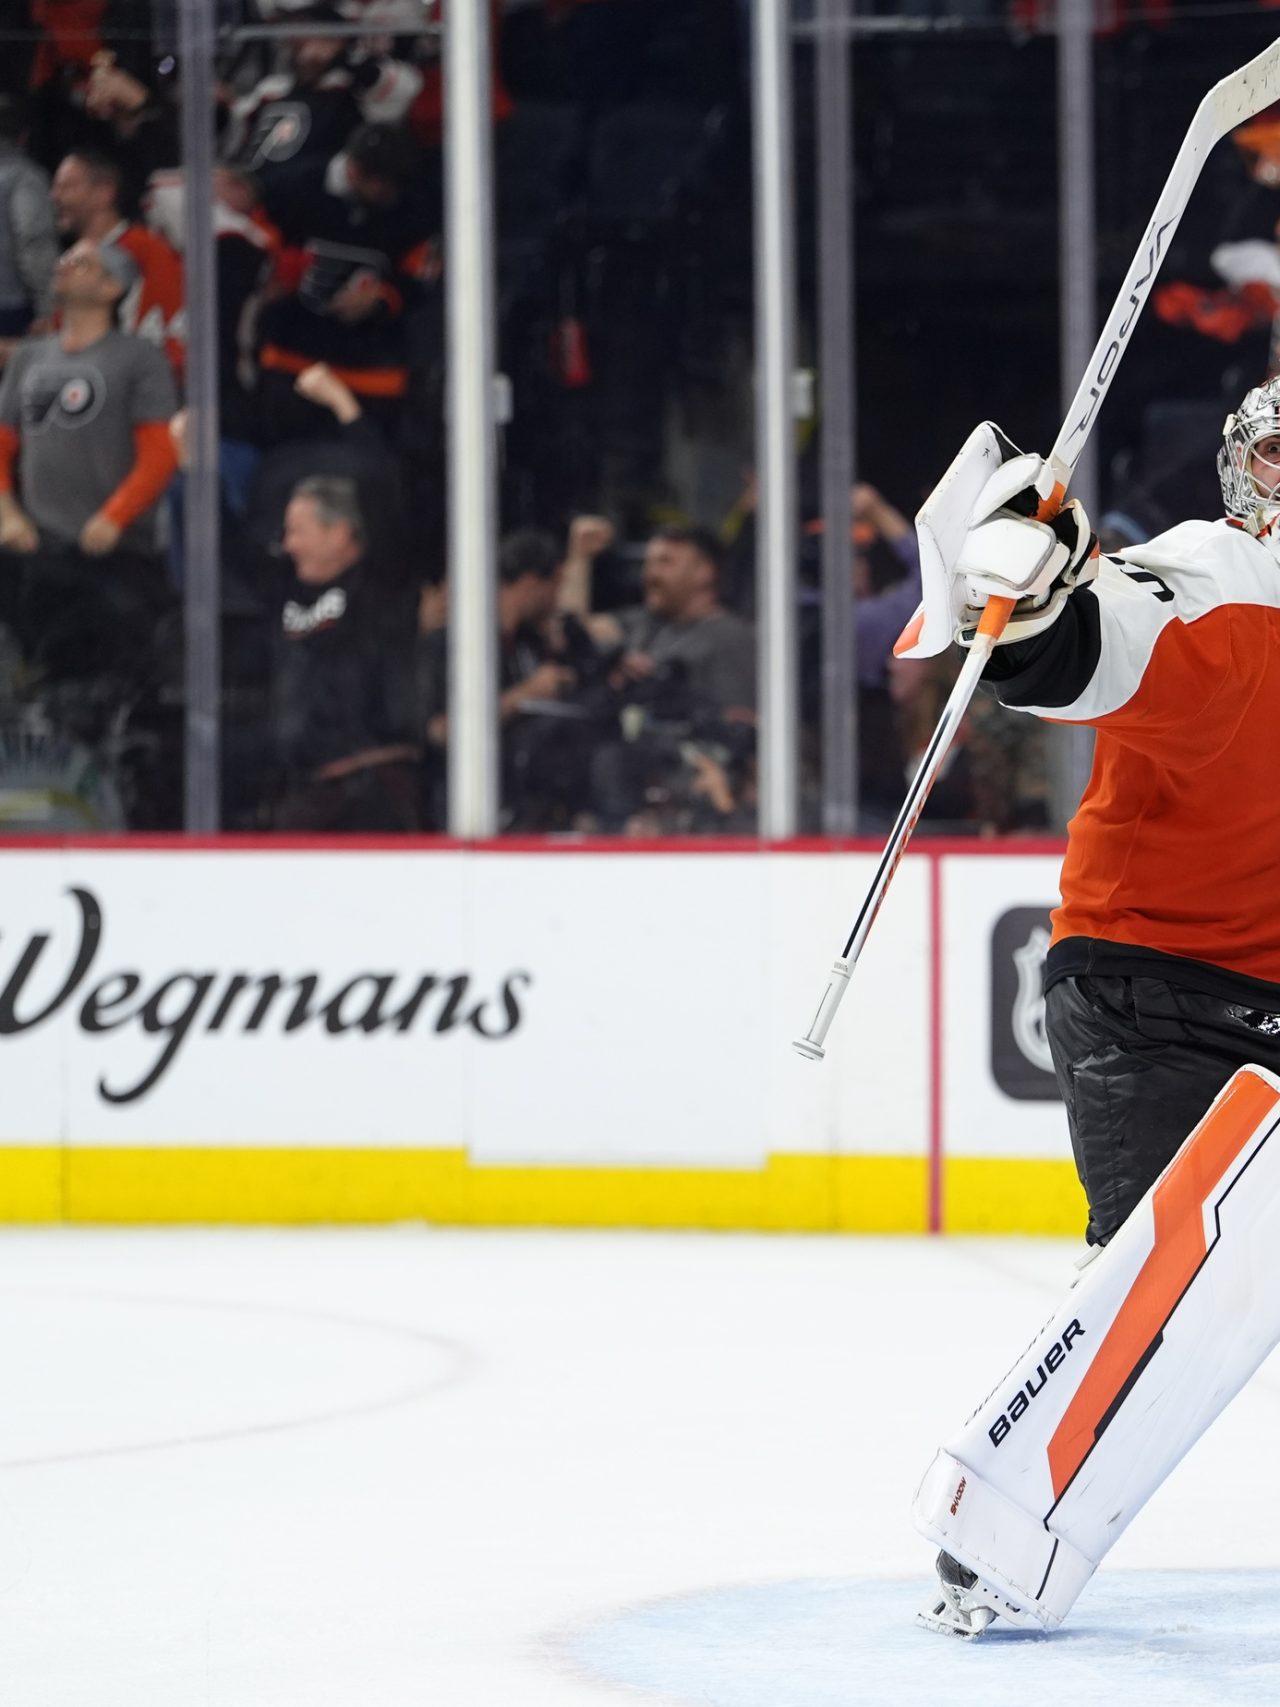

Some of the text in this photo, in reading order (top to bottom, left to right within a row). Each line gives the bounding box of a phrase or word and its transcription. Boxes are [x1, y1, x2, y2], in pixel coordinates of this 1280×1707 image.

[1064, 214, 1179, 445] VAPOR
[988, 1318, 1086, 1448] BAUER
[950, 1476, 968, 1516] SHADOW
